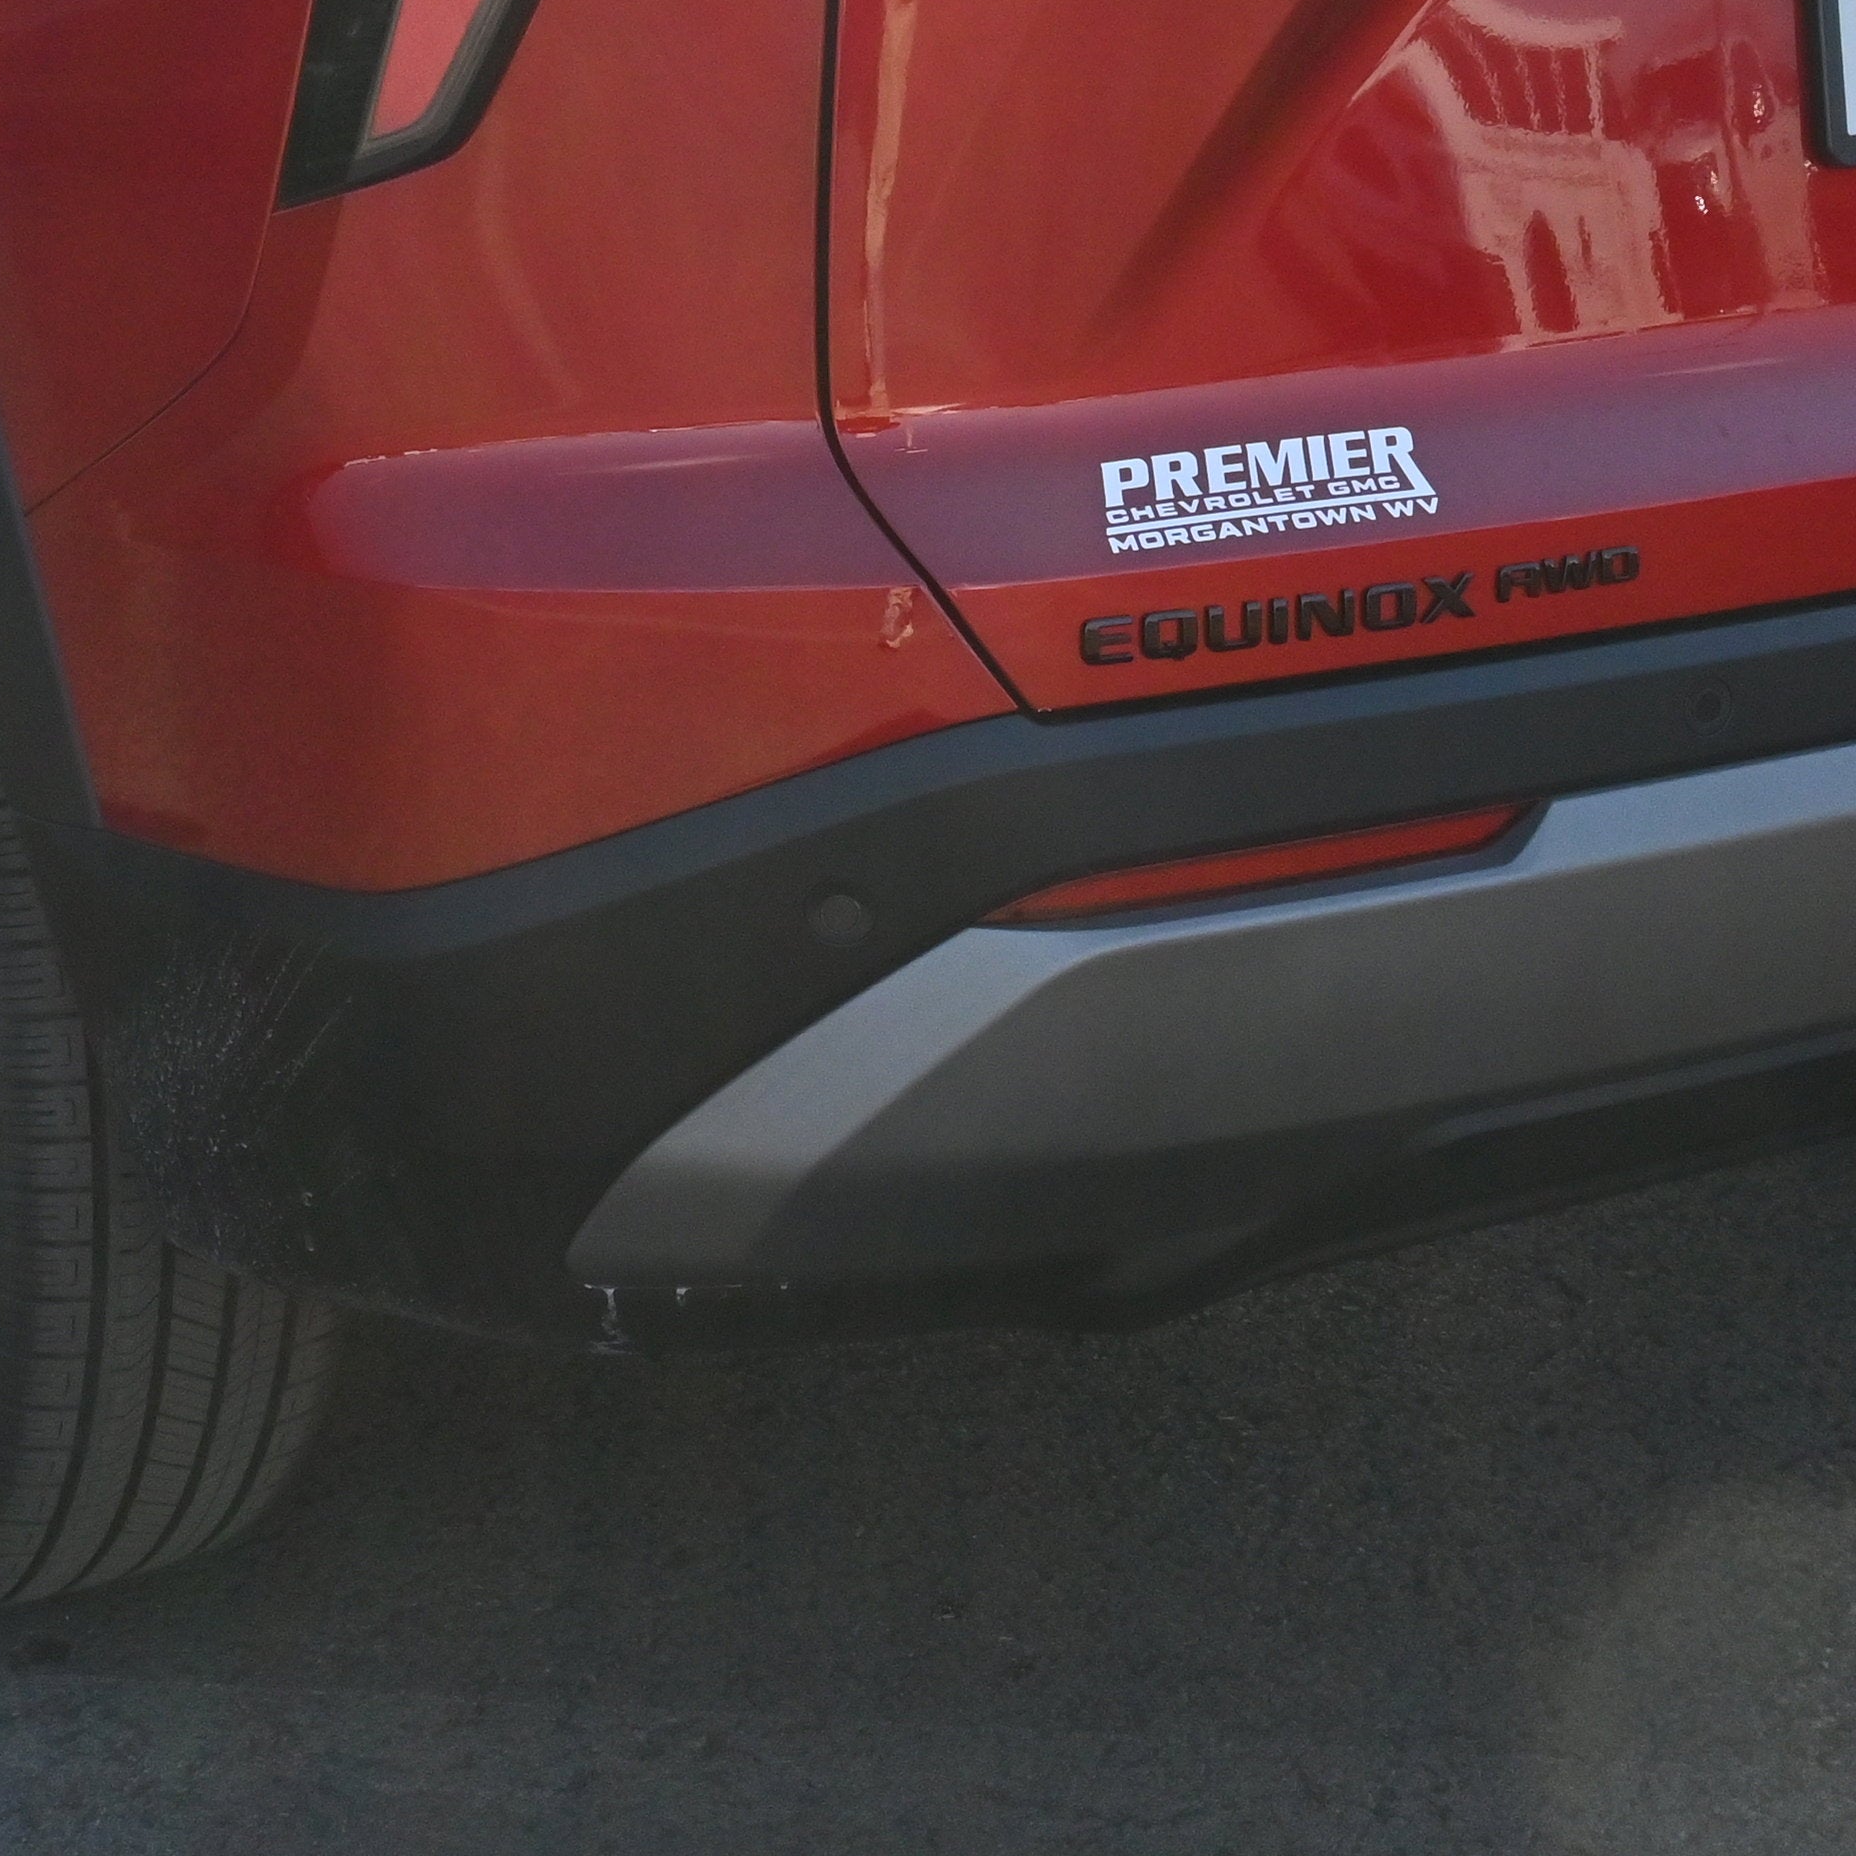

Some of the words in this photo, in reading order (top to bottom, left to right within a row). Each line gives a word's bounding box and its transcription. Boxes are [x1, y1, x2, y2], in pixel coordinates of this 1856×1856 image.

[1100, 426, 1436, 507] PREMIER
[1105, 485, 1315, 524] CHEVROLET
[1327, 474, 1401, 496] GMC
[1109, 503, 1376, 554] MORGANTOWN
[1382, 497, 1439, 518] WV
[1079, 571, 1476, 666] EQUINOX
[1496, 544, 1640, 603] AWD
